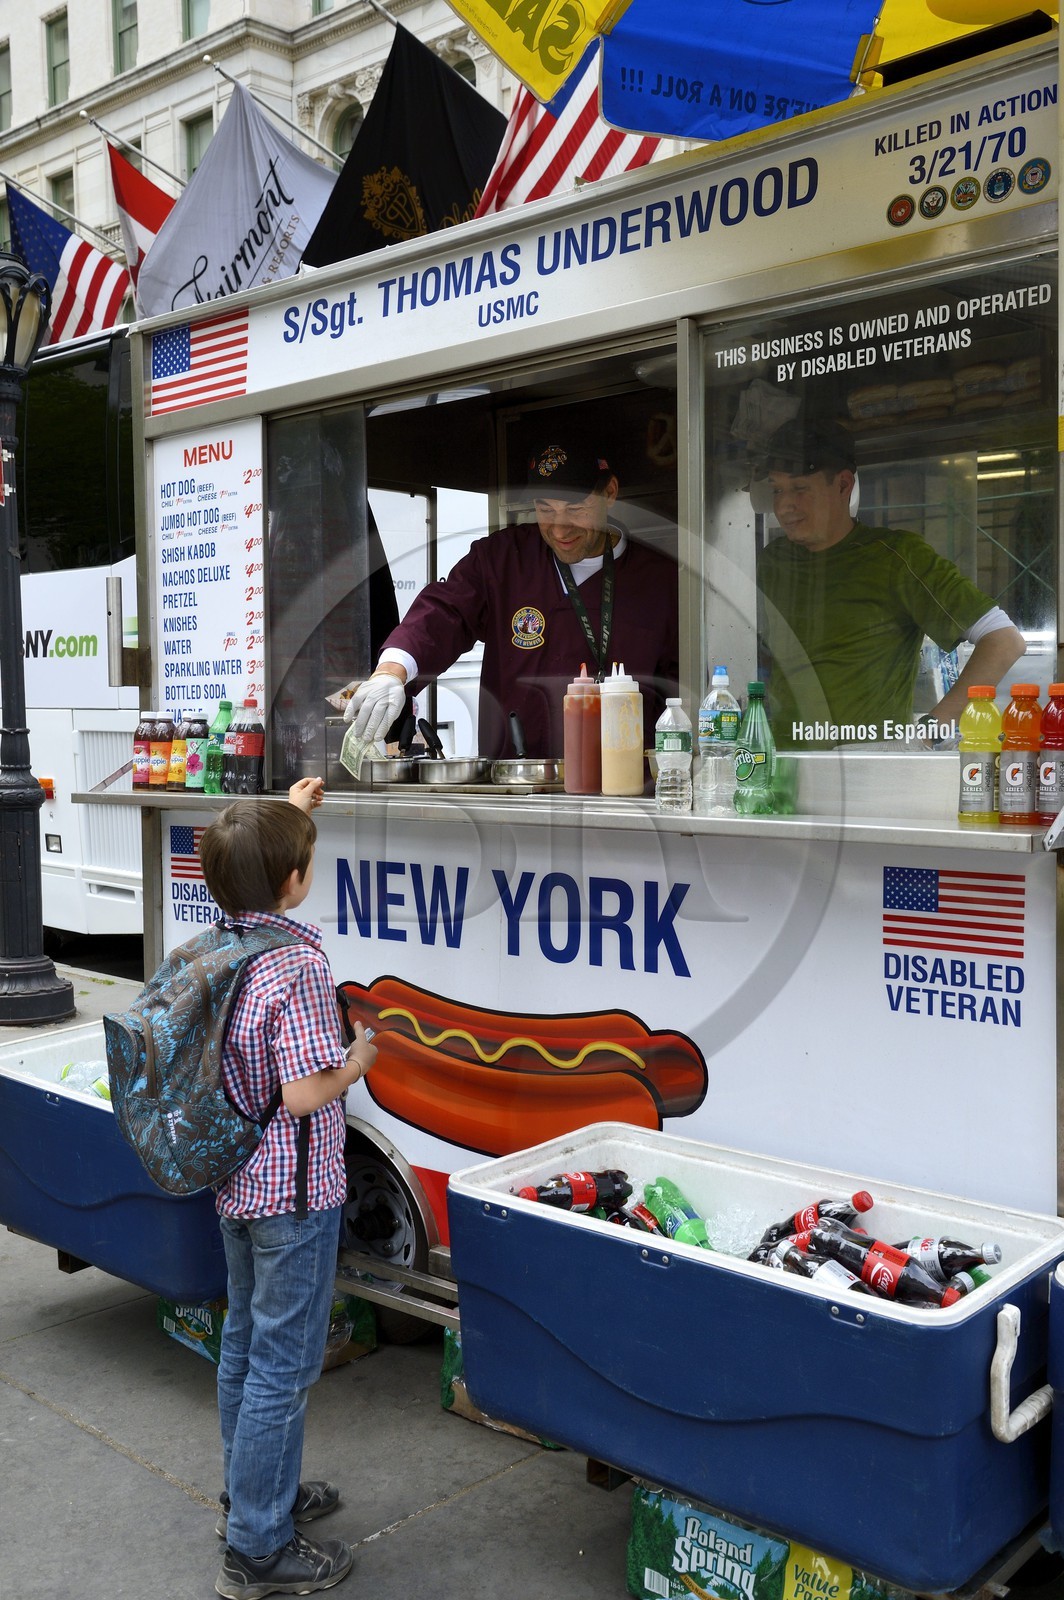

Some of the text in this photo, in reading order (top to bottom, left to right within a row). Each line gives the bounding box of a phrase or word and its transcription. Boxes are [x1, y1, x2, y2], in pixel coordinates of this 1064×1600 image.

[875, 84, 1058, 156] KILLED IN ACTION
[908, 126, 1027, 185] 3/21/70
[268, 214, 300, 274] RESORTS
[283, 291, 363, 343] S/Sgt.
[377, 243, 521, 318] THOMAS
[536, 156, 819, 276] UNDERWOOD
[477, 291, 539, 327] USMC
[715, 283, 1052, 369] THIS BUSINESS IS OWNED AND OPERATED
[777, 328, 972, 382] BY DISABLED VETERANS
[183, 440, 233, 467] MENU
[160, 478, 214, 499] HOT DOG (BEEF)
[161, 499, 174, 508] CHILI
[197, 492, 217, 502] CHEESE
[161, 507, 237, 531] JUMBO HOT DOG (BEEF)
[161, 532, 174, 541] CHILI
[198, 526, 218, 535] CHEESE
[161, 542, 216, 564] SHISH KABOB
[162, 565, 231, 587] NACHOS DELUXE
[163, 592, 198, 609] PRETZEL
[163, 616, 197, 633] KNISHES
[164, 640, 192, 655] WATER
[164, 659, 242, 678] SPARKLING WATER
[165, 683, 227, 701] BOTTLED SODA
[792, 719, 956, 744] Hablamos Español
[962, 762, 982, 786] G
[1006, 762, 1023, 786] G
[173, 903, 226, 924] VETERA
[337, 858, 691, 977] NEW YORK
[884, 952, 1024, 994] DISABLED
[886, 984, 1021, 1028] VETERAN
[685, 1516, 753, 1566] Poland
[794, 1563, 840, 1598] Value
